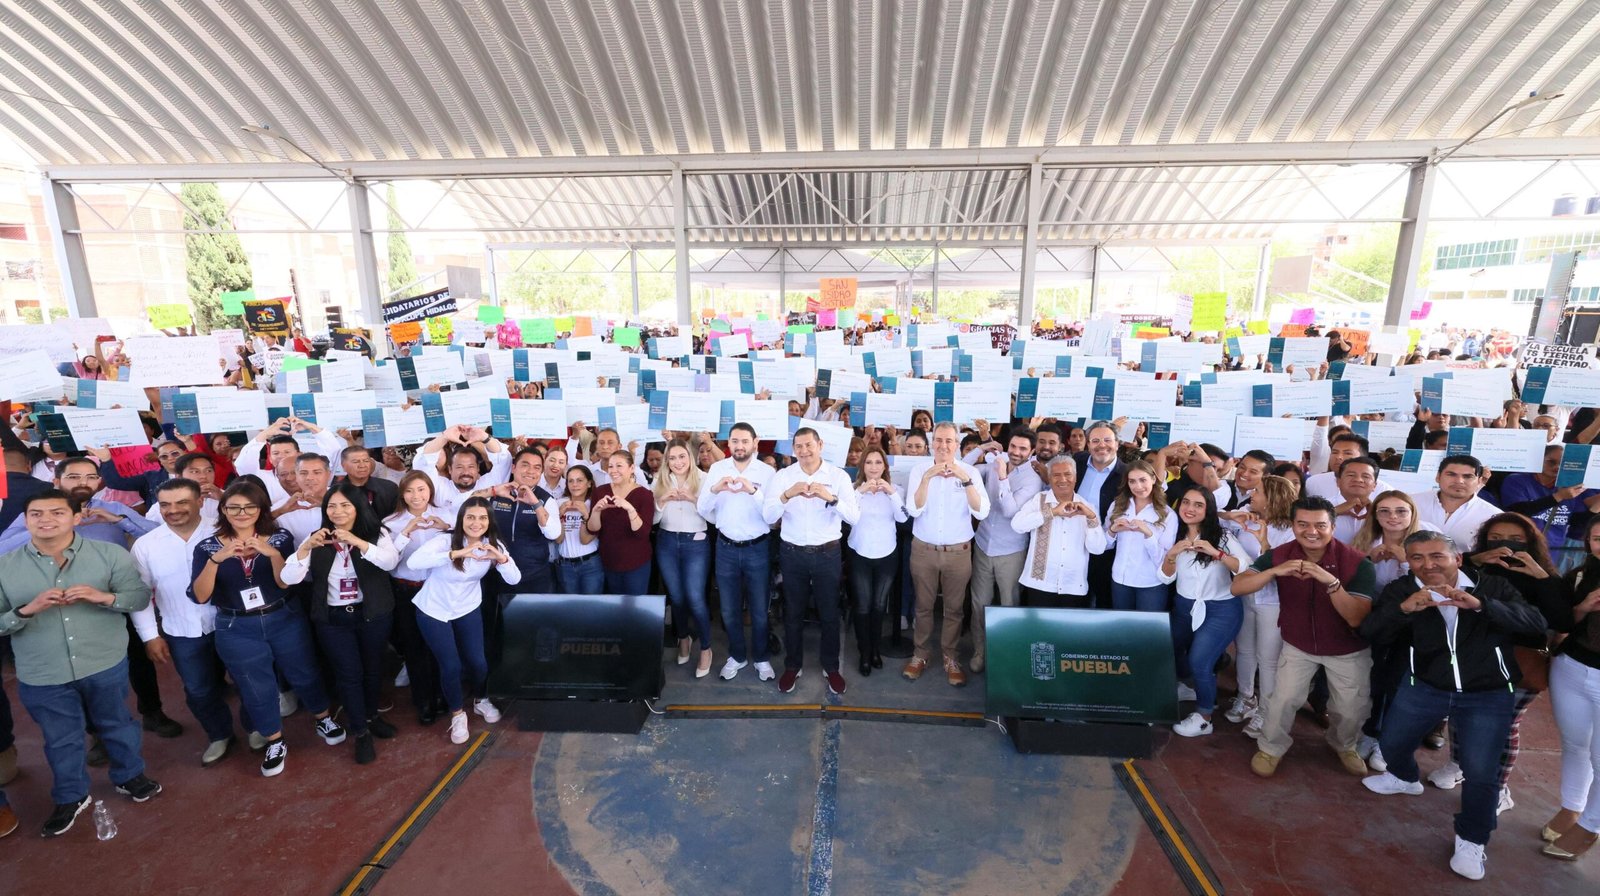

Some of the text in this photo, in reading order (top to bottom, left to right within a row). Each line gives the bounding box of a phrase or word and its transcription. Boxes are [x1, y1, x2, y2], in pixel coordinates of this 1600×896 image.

[828, 279, 849, 290] SAN
[437, 291, 449, 300] DE
[426, 302, 457, 316] HIDALGO
[970, 325, 1005, 334] GRACIAS
[1543, 345, 1589, 355] ESCUELA
[1542, 351, 1584, 361] TIERRA
[560, 643, 621, 655] PUEBLA
[1060, 660, 1131, 675] PUEBLA
